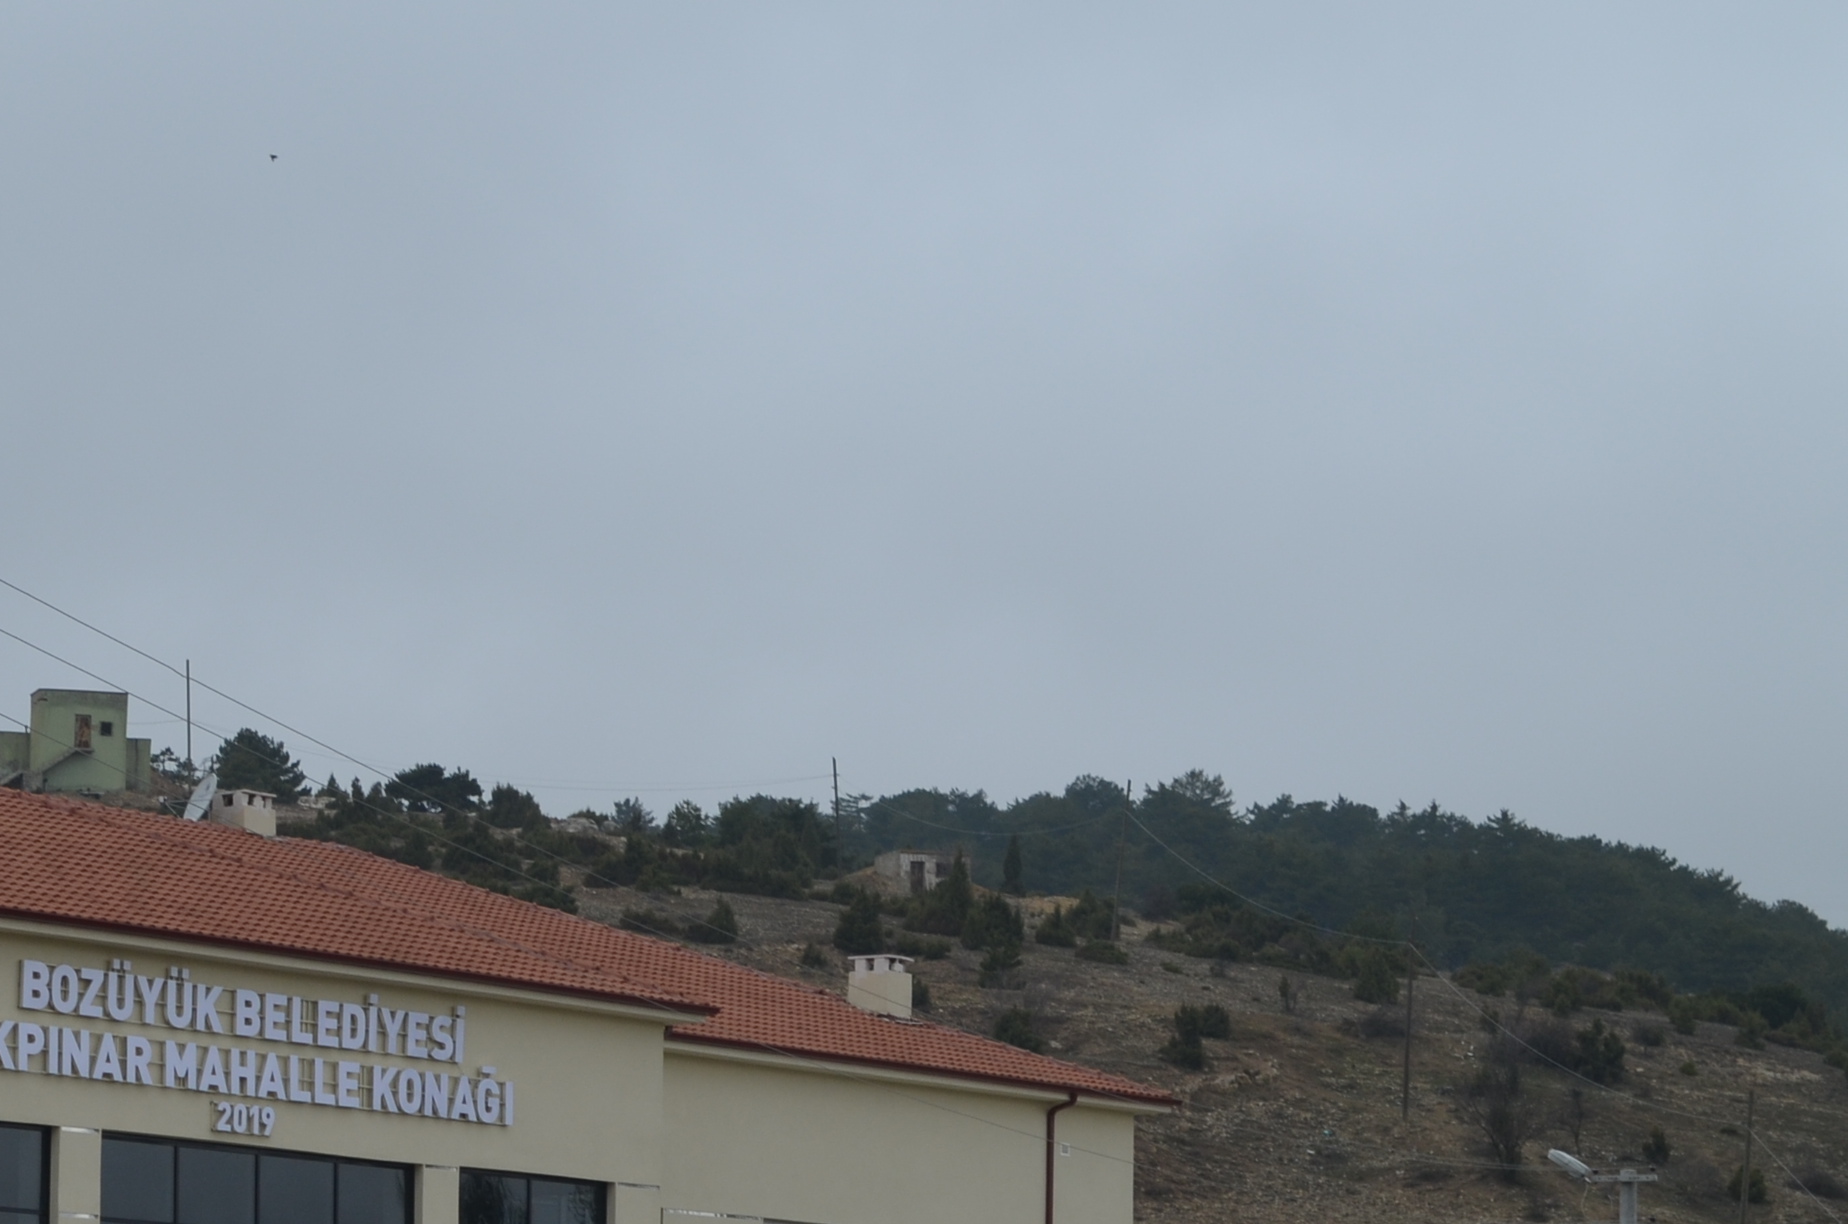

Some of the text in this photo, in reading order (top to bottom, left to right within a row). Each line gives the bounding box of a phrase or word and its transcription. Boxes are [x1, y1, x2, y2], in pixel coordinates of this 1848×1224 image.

[19, 958, 467, 1064] BOZÜYÜK BELEDİYESİ
[164, 1039, 361, 1108] MAHALLE
[372, 1065, 515, 1126] KONAĞI
[215, 1100, 275, 1136] 2019
